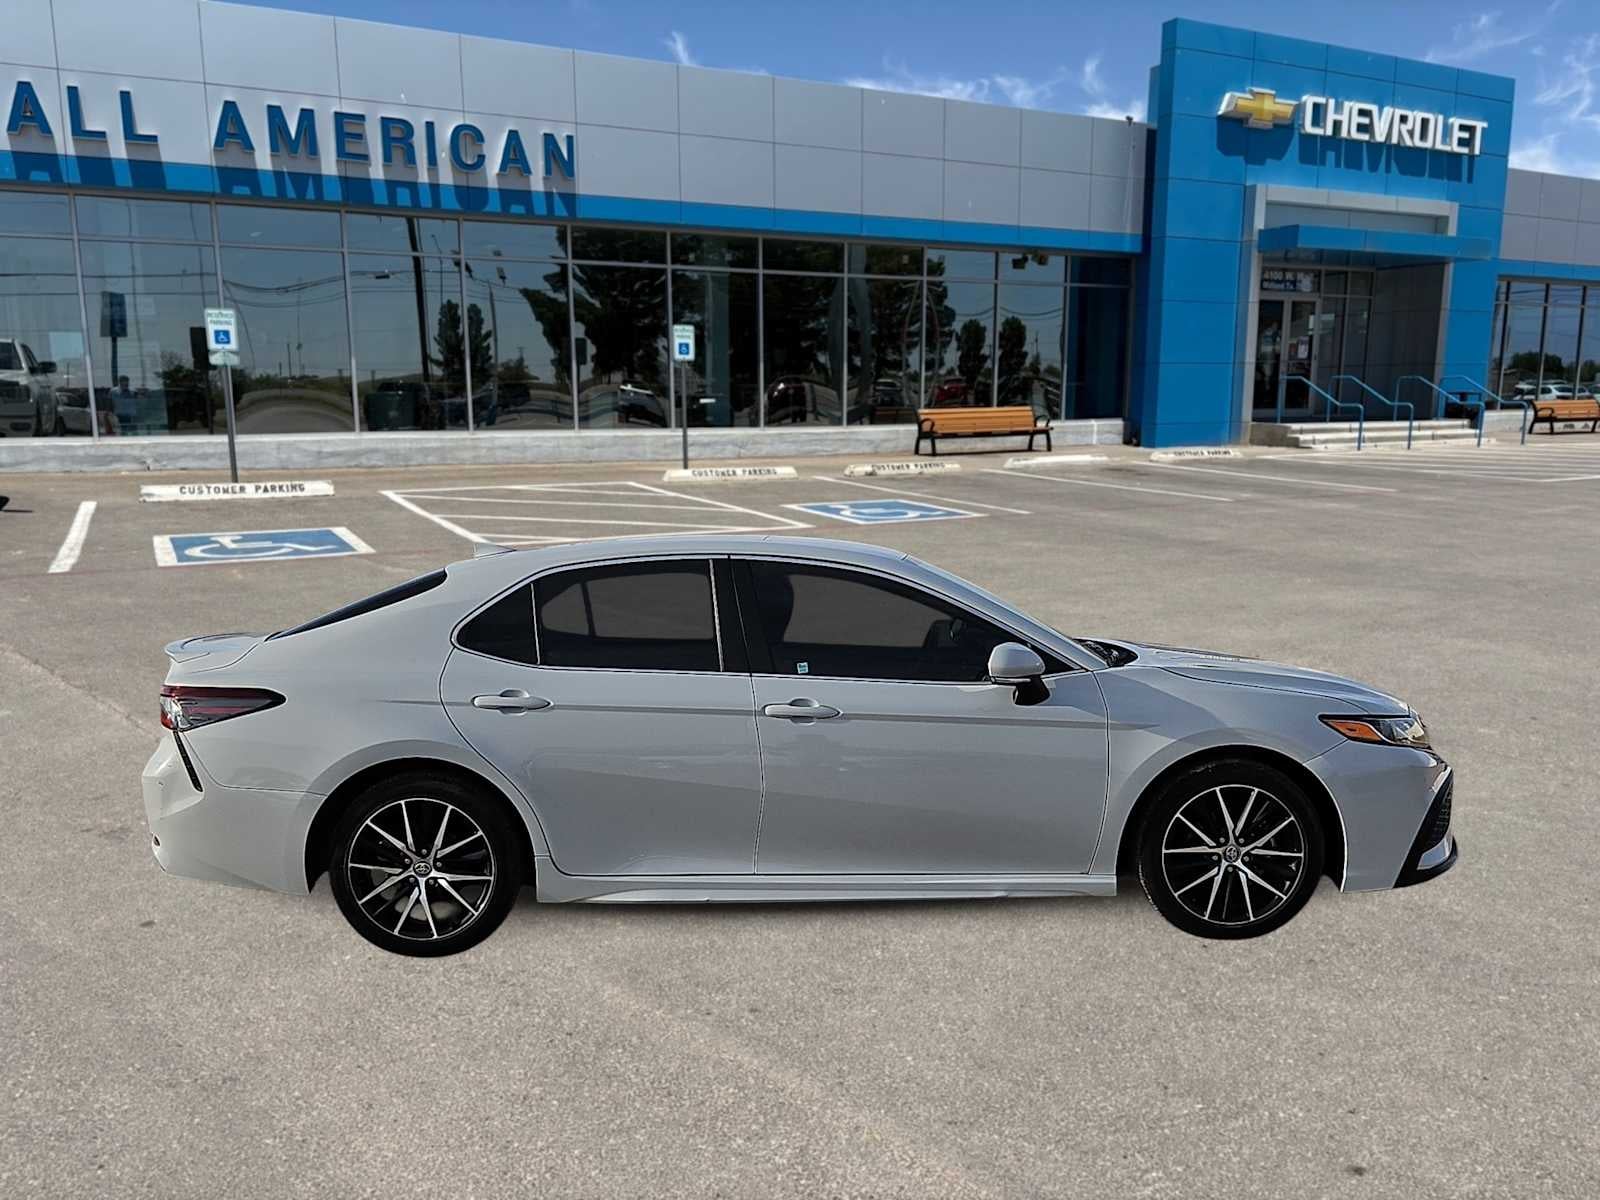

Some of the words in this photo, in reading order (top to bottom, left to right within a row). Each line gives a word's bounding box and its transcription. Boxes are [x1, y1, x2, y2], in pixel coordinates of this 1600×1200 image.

[6, 81, 159, 144] ALL
[213, 99, 576, 179] AMERICAN
[1301, 95, 1488, 155] CHEVROLET
[179, 485, 246, 496] CUSTOMER
[254, 483, 306, 494] PARKING
[692, 469, 737, 477] CUSTOMER
[742, 468, 778, 476] PARKING
